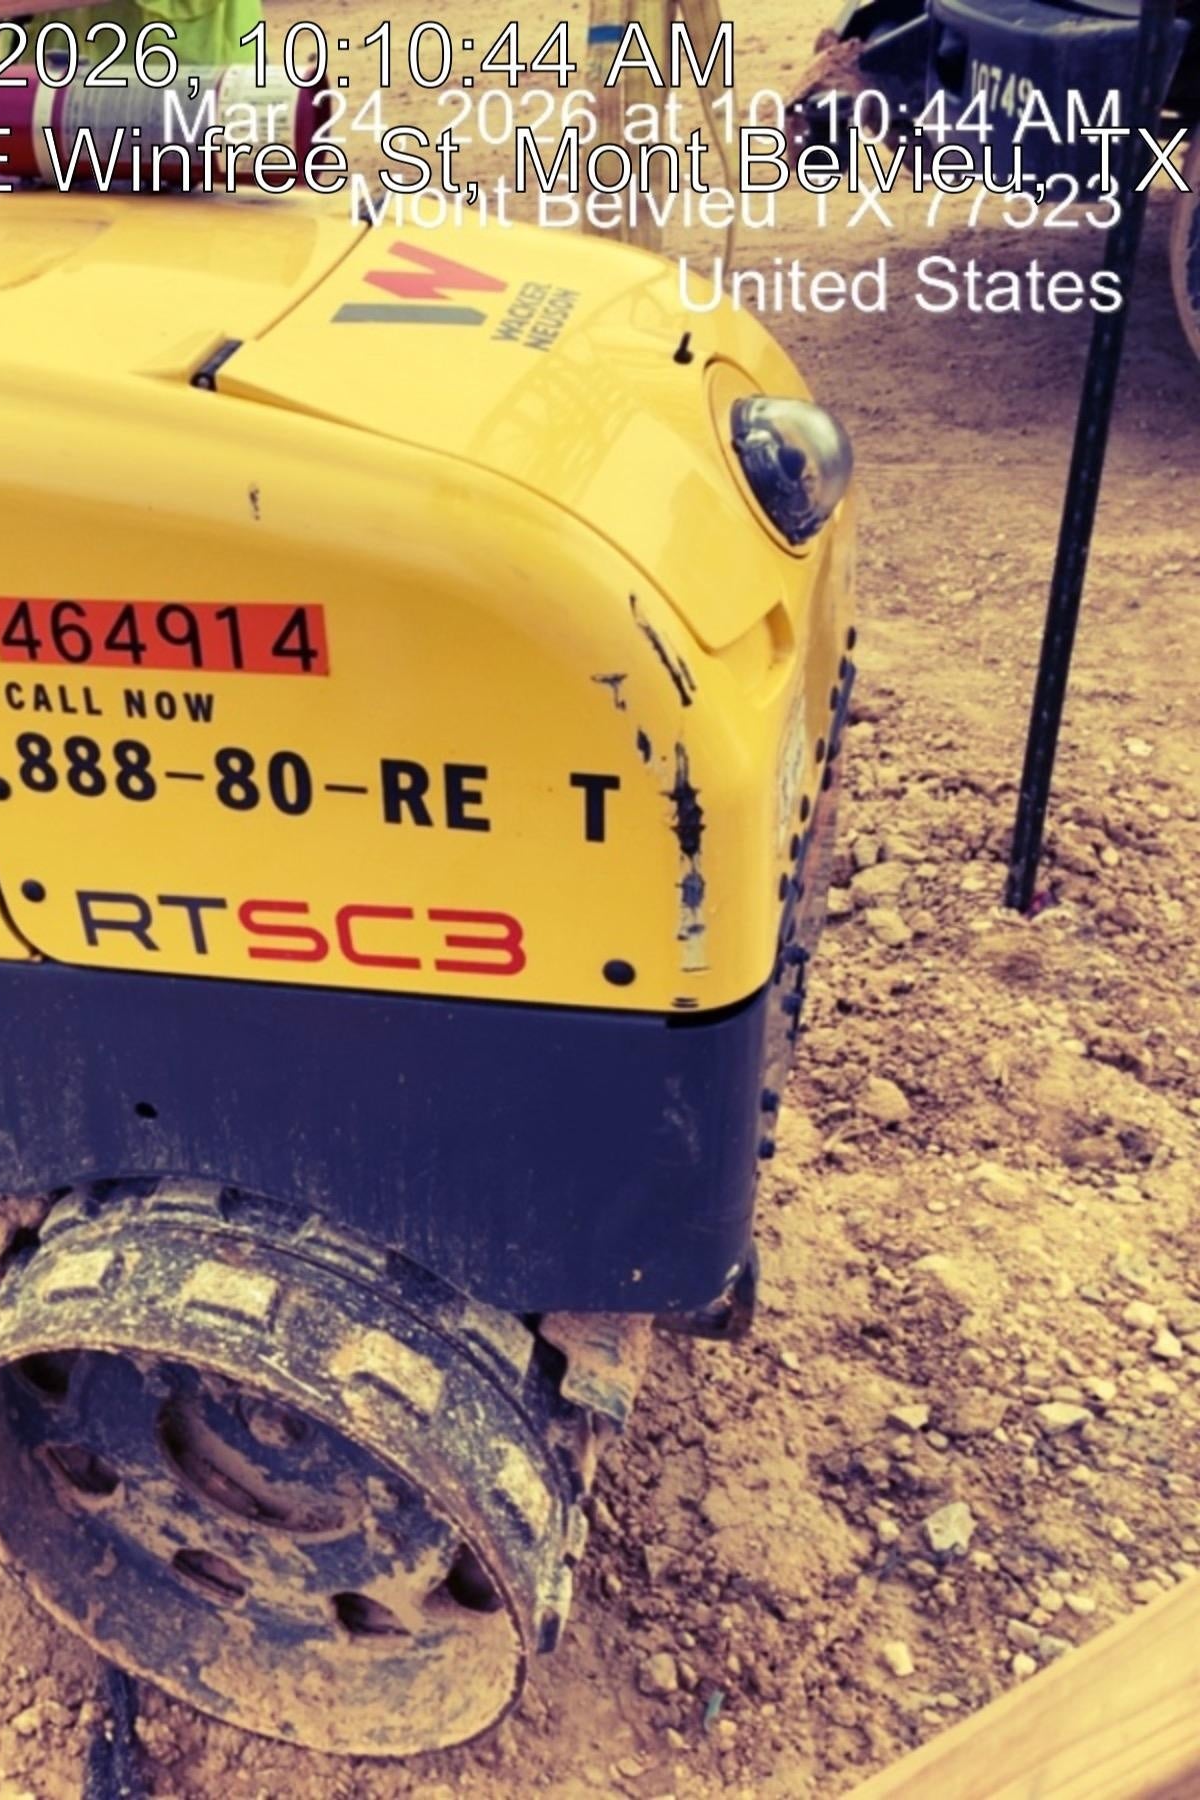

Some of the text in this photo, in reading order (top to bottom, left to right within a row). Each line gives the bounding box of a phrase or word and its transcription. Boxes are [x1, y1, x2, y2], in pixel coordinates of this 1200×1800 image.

[490, 281, 552, 341] WACKER
[522, 287, 581, 352] NEUSON
[0, 600, 319, 672] 464914
[5, 681, 214, 722] CALL NOW
[75, 890, 527, 976] RTSC3
